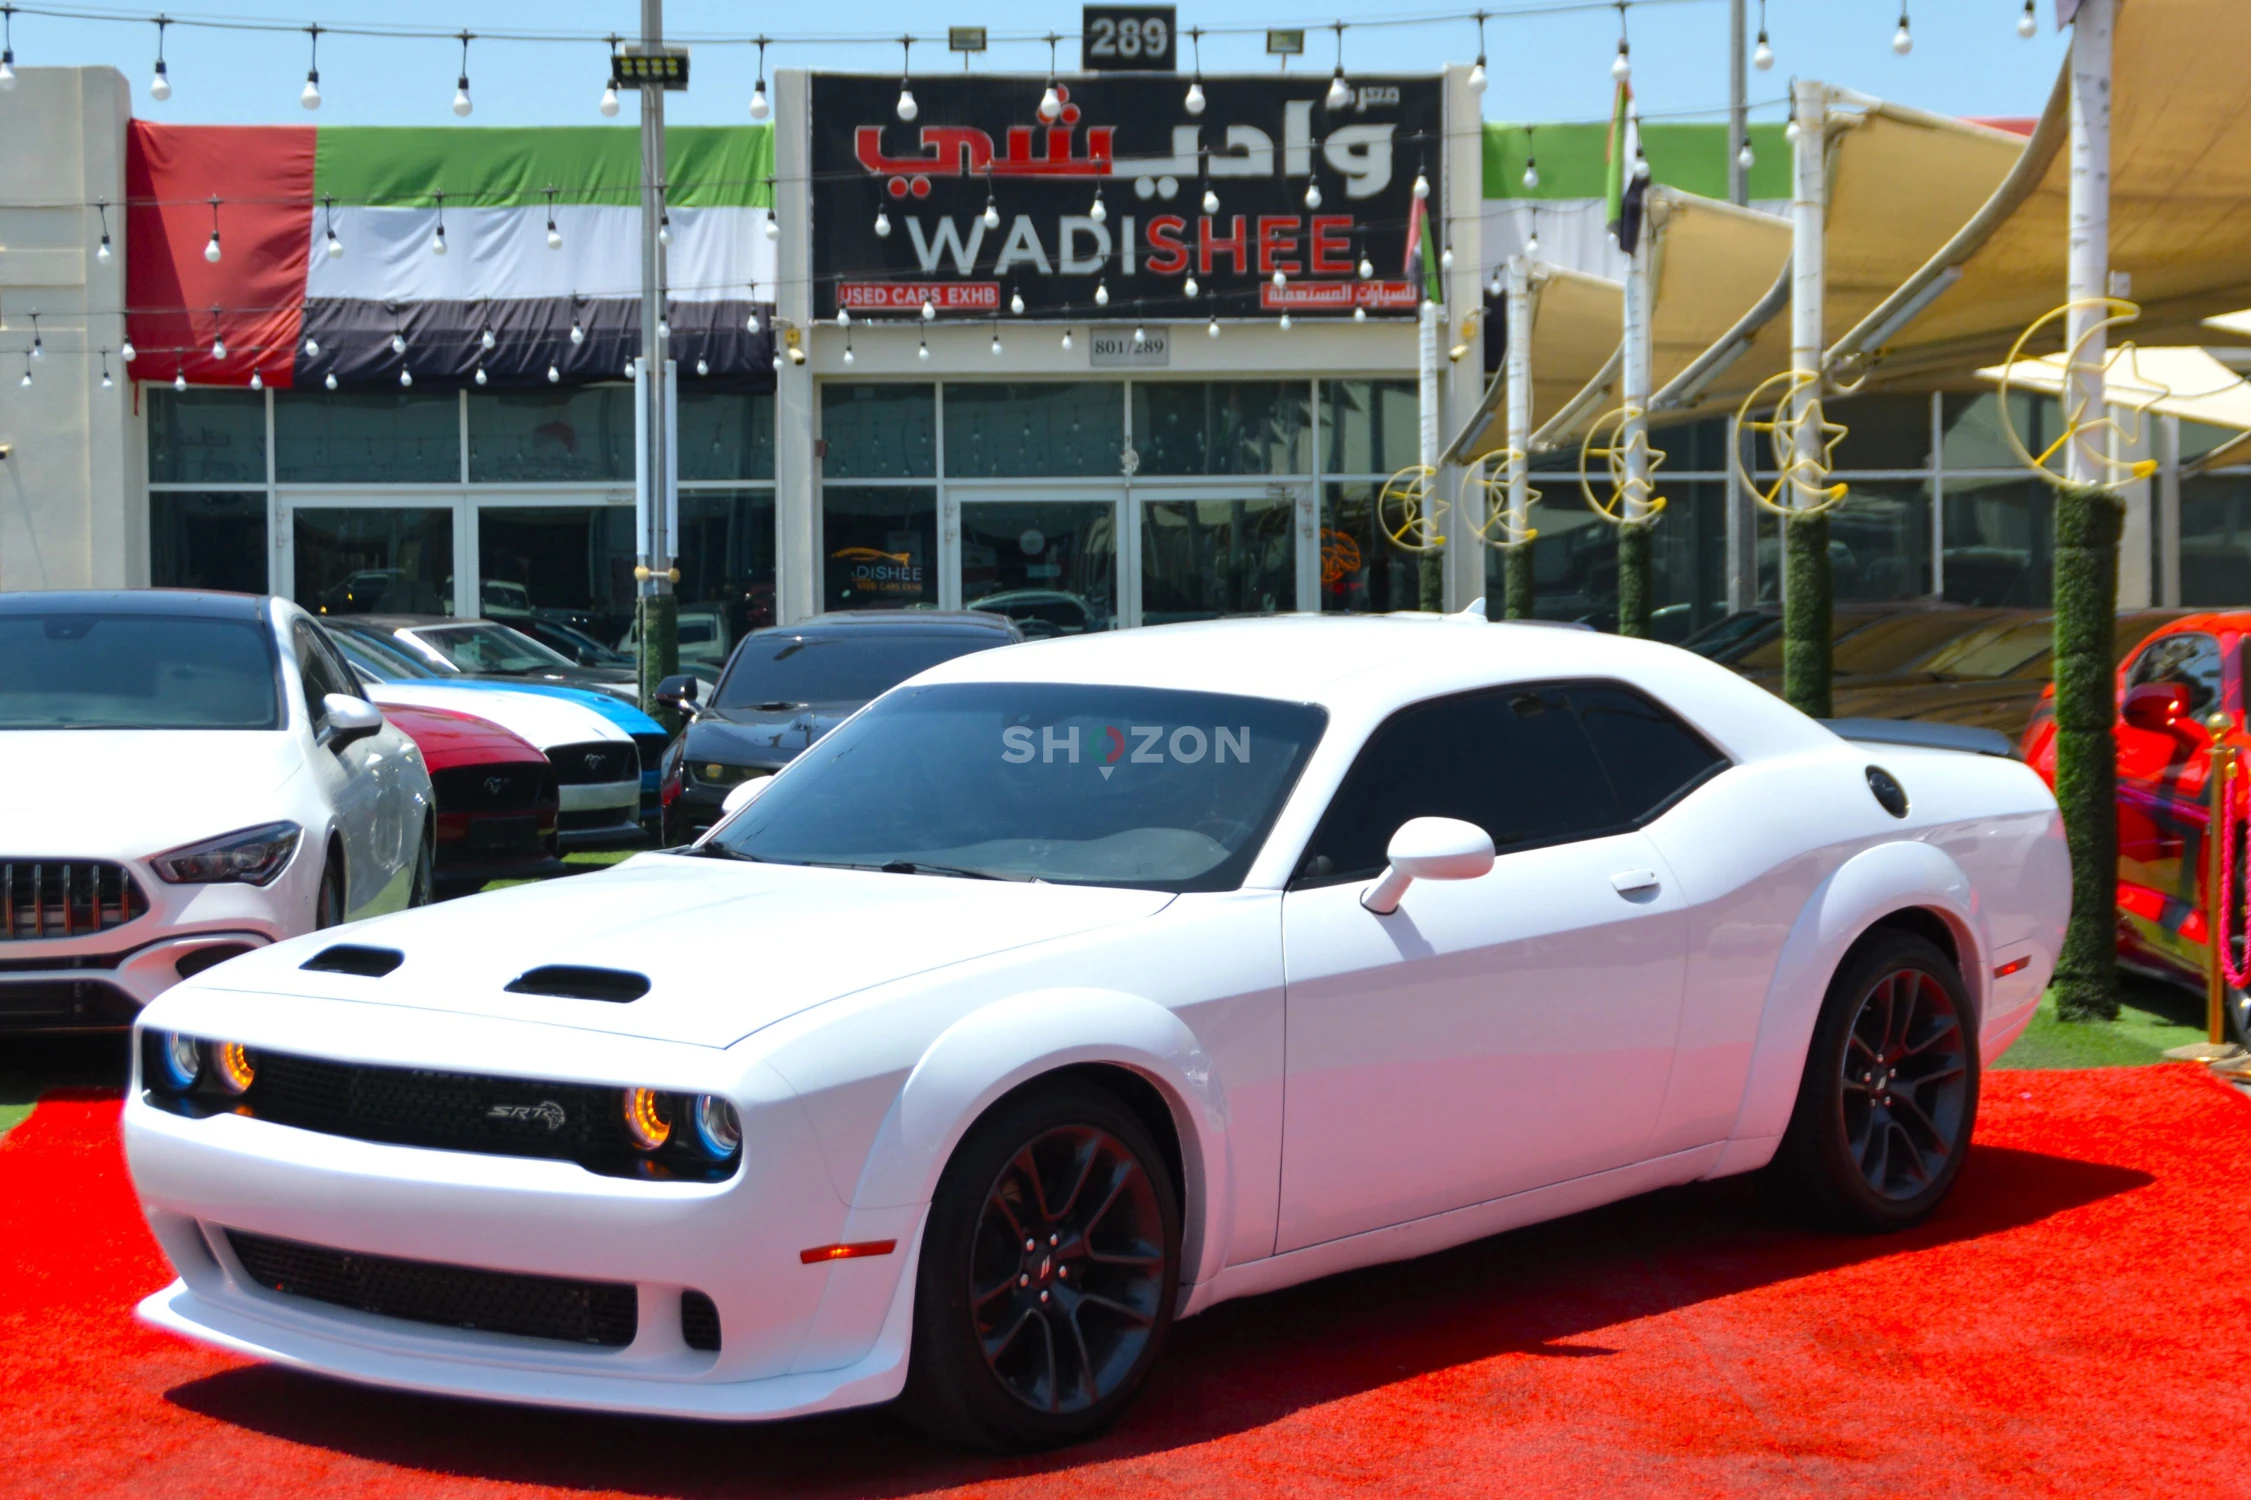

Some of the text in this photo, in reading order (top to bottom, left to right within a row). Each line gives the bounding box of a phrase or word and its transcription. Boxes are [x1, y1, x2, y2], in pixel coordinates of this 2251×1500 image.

[1090, 17, 1168, 57] 289
[906, 214, 1354, 276] WADISHEE
[839, 286, 996, 304] USED CARS EXHB
[1095, 339, 1164, 354] 801/289
[487, 1106, 548, 1120] SRT
